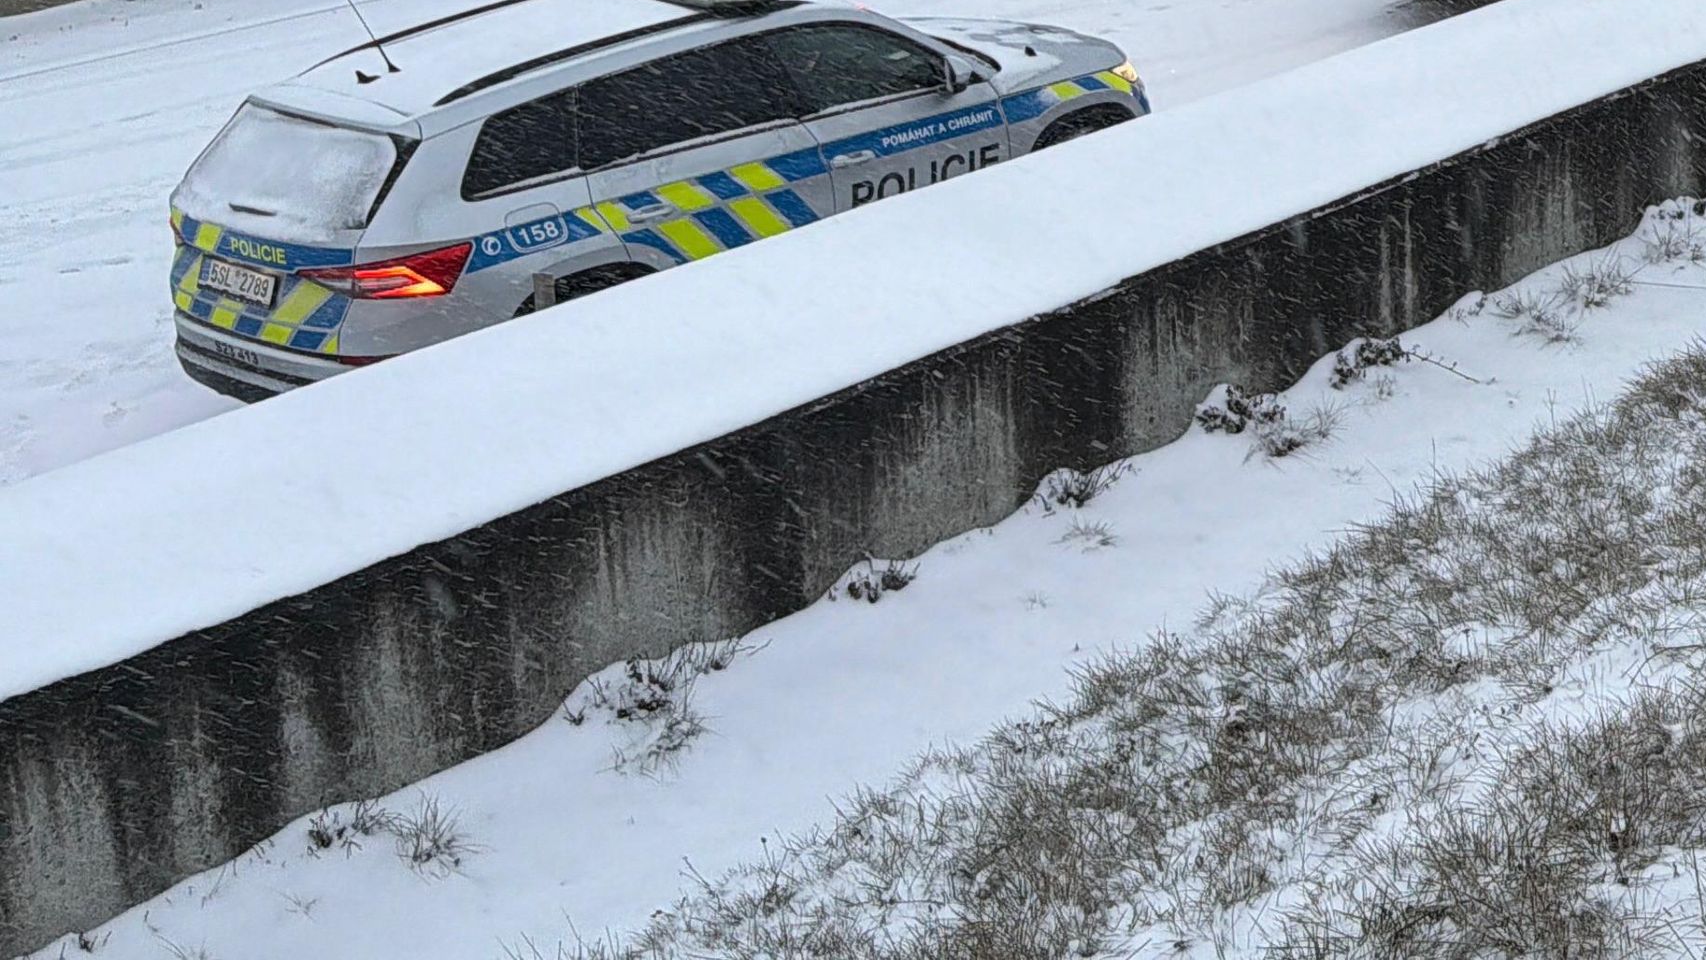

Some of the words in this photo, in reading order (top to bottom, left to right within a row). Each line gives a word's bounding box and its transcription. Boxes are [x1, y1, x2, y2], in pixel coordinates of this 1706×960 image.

[882, 124, 936, 148] POMÁHAT
[938, 123, 947, 133] A
[948, 109, 994, 131] CHRÁNIT
[518, 221, 560, 245] 158
[230, 238, 288, 265] POLICIE
[209, 262, 233, 288] 5SL
[238, 271, 270, 298] 2789
